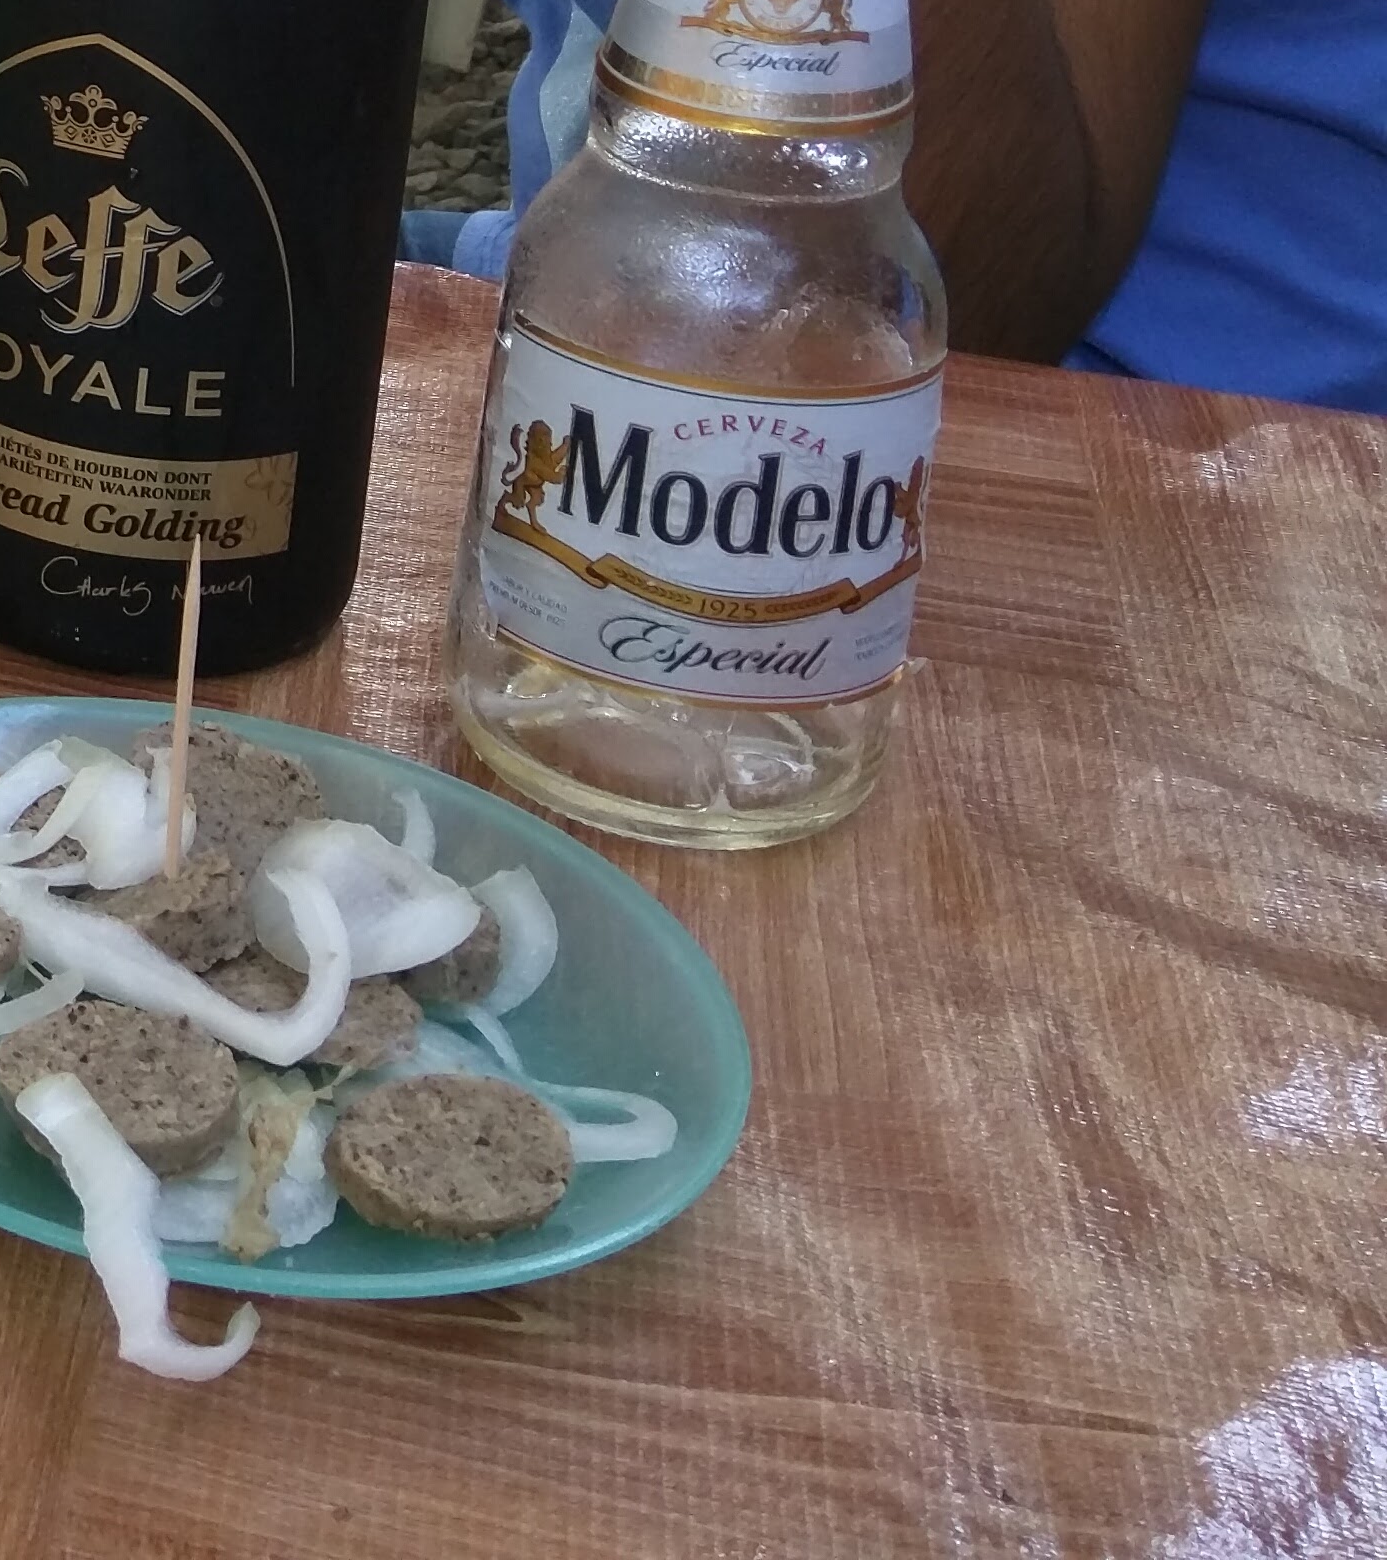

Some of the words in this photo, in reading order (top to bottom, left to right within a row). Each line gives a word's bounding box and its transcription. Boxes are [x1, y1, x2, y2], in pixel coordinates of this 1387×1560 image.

[709, 39, 841, 77] Especial
[673, 414, 828, 456] CERVEZA
[47, 451, 69, 470] DE
[74, 458, 158, 483] HOUBLON
[164, 470, 213, 485] DONT
[557, 403, 896, 558] Modelo
[99, 480, 212, 502] WAARONDER
[83, 503, 246, 550] Golding
[698, 598, 758, 619] 1925
[598, 616, 834, 681] Especial
